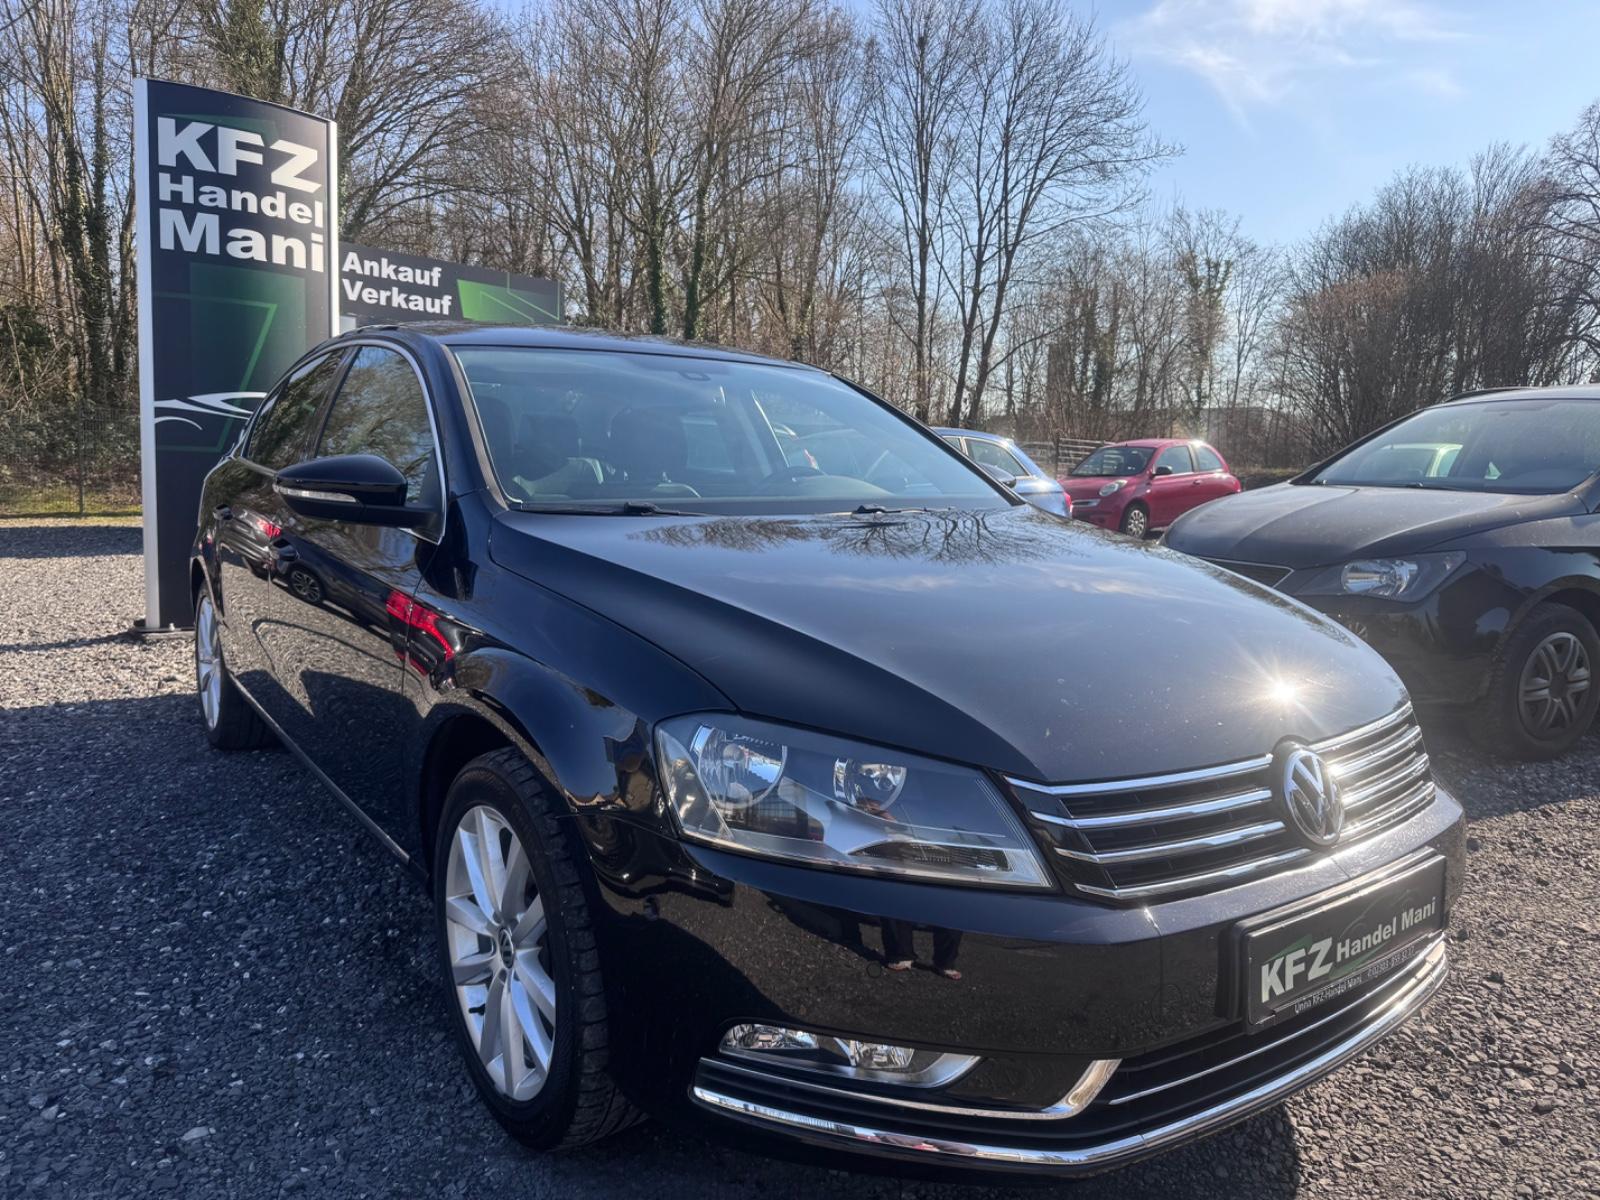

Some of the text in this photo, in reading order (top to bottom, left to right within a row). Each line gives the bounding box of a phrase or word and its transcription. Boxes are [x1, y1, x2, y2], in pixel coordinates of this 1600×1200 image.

[157, 116, 323, 194] KFZ
[158, 172, 324, 228] Handel
[158, 208, 325, 273] Mani
[342, 252, 442, 288] Ankauf
[342, 279, 453, 315] Verkauf
[1261, 936, 1333, 1003] KFZ
[1336, 916, 1397, 963] Handel
[1401, 896, 1436, 931] Mani
